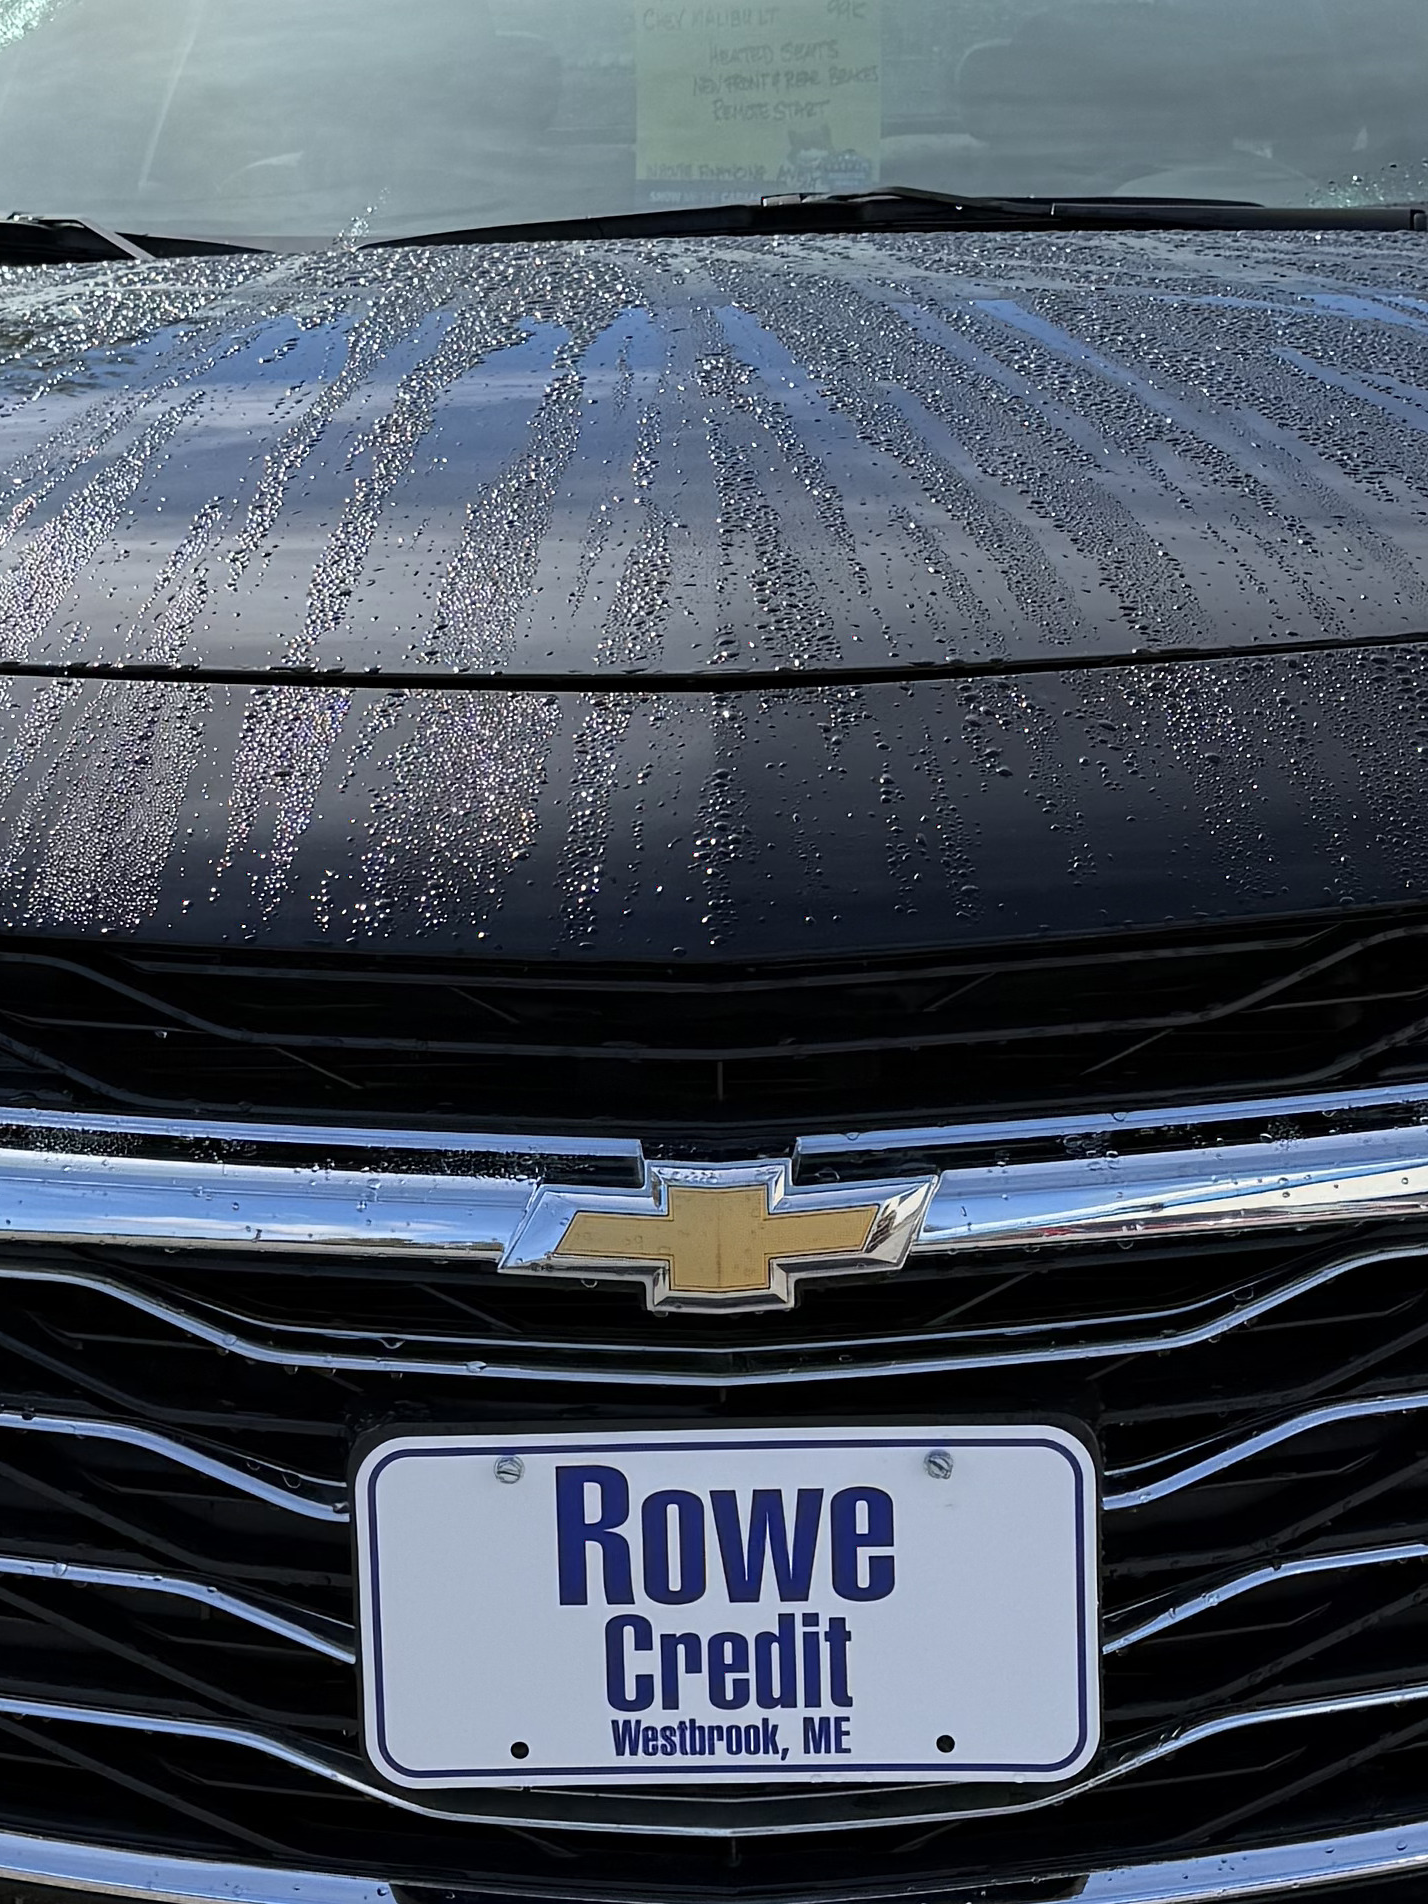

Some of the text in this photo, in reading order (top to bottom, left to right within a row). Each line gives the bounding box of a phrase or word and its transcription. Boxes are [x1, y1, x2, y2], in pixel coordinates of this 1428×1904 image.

[554, 1463, 897, 1606] Rowe
[604, 1612, 855, 1712] Credit
[610, 1716, 852, 1763] Westbrook, ME
